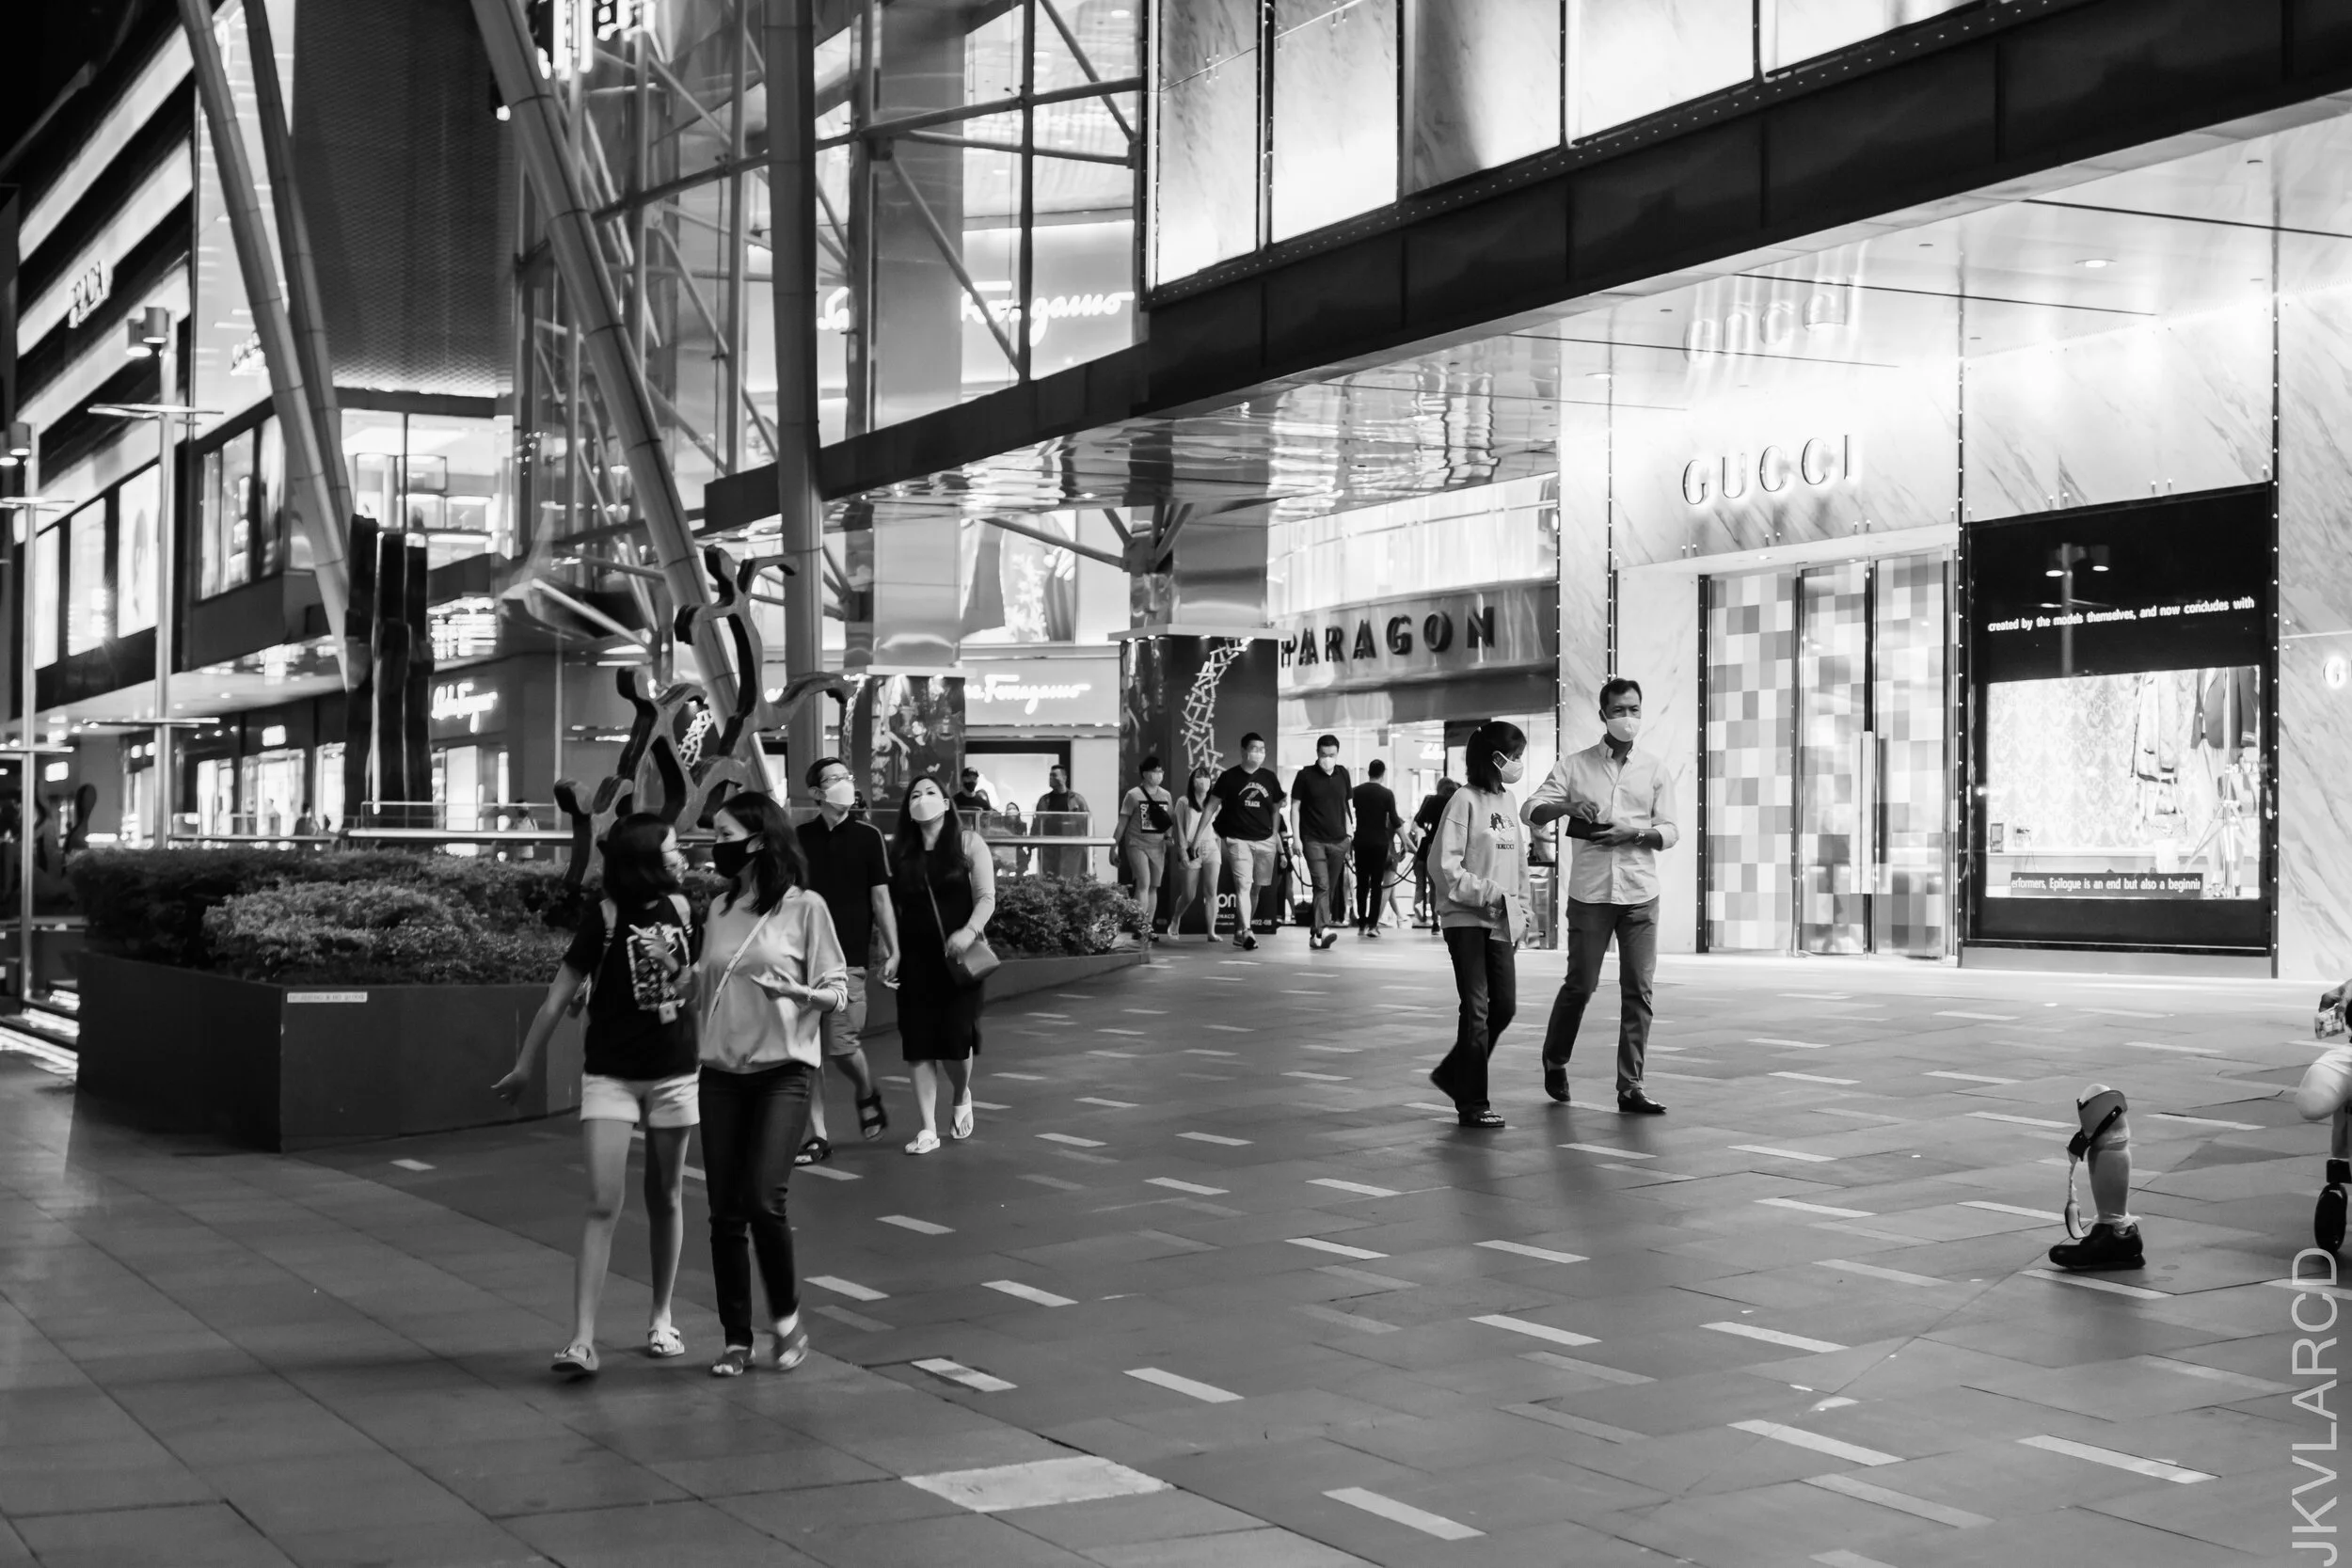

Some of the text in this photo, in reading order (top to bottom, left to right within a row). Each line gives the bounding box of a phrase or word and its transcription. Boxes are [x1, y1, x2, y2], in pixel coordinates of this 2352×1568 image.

[1682, 435, 1853, 505] GUCCI
[1987, 596, 2255, 632] created by the models themselves, and now concludes with
[1280, 606, 1496, 669] PARAGON
[2323, 657, 2352, 689] G
[2049, 876, 2082, 892] Epilogue
[2084, 877, 2090, 889] is
[2093, 879, 2104, 890] an
[2106, 877, 2122, 890] end
[2123, 877, 2138, 890] but
[2140, 877, 2157, 890] also
[2159, 879, 2165, 890] a
